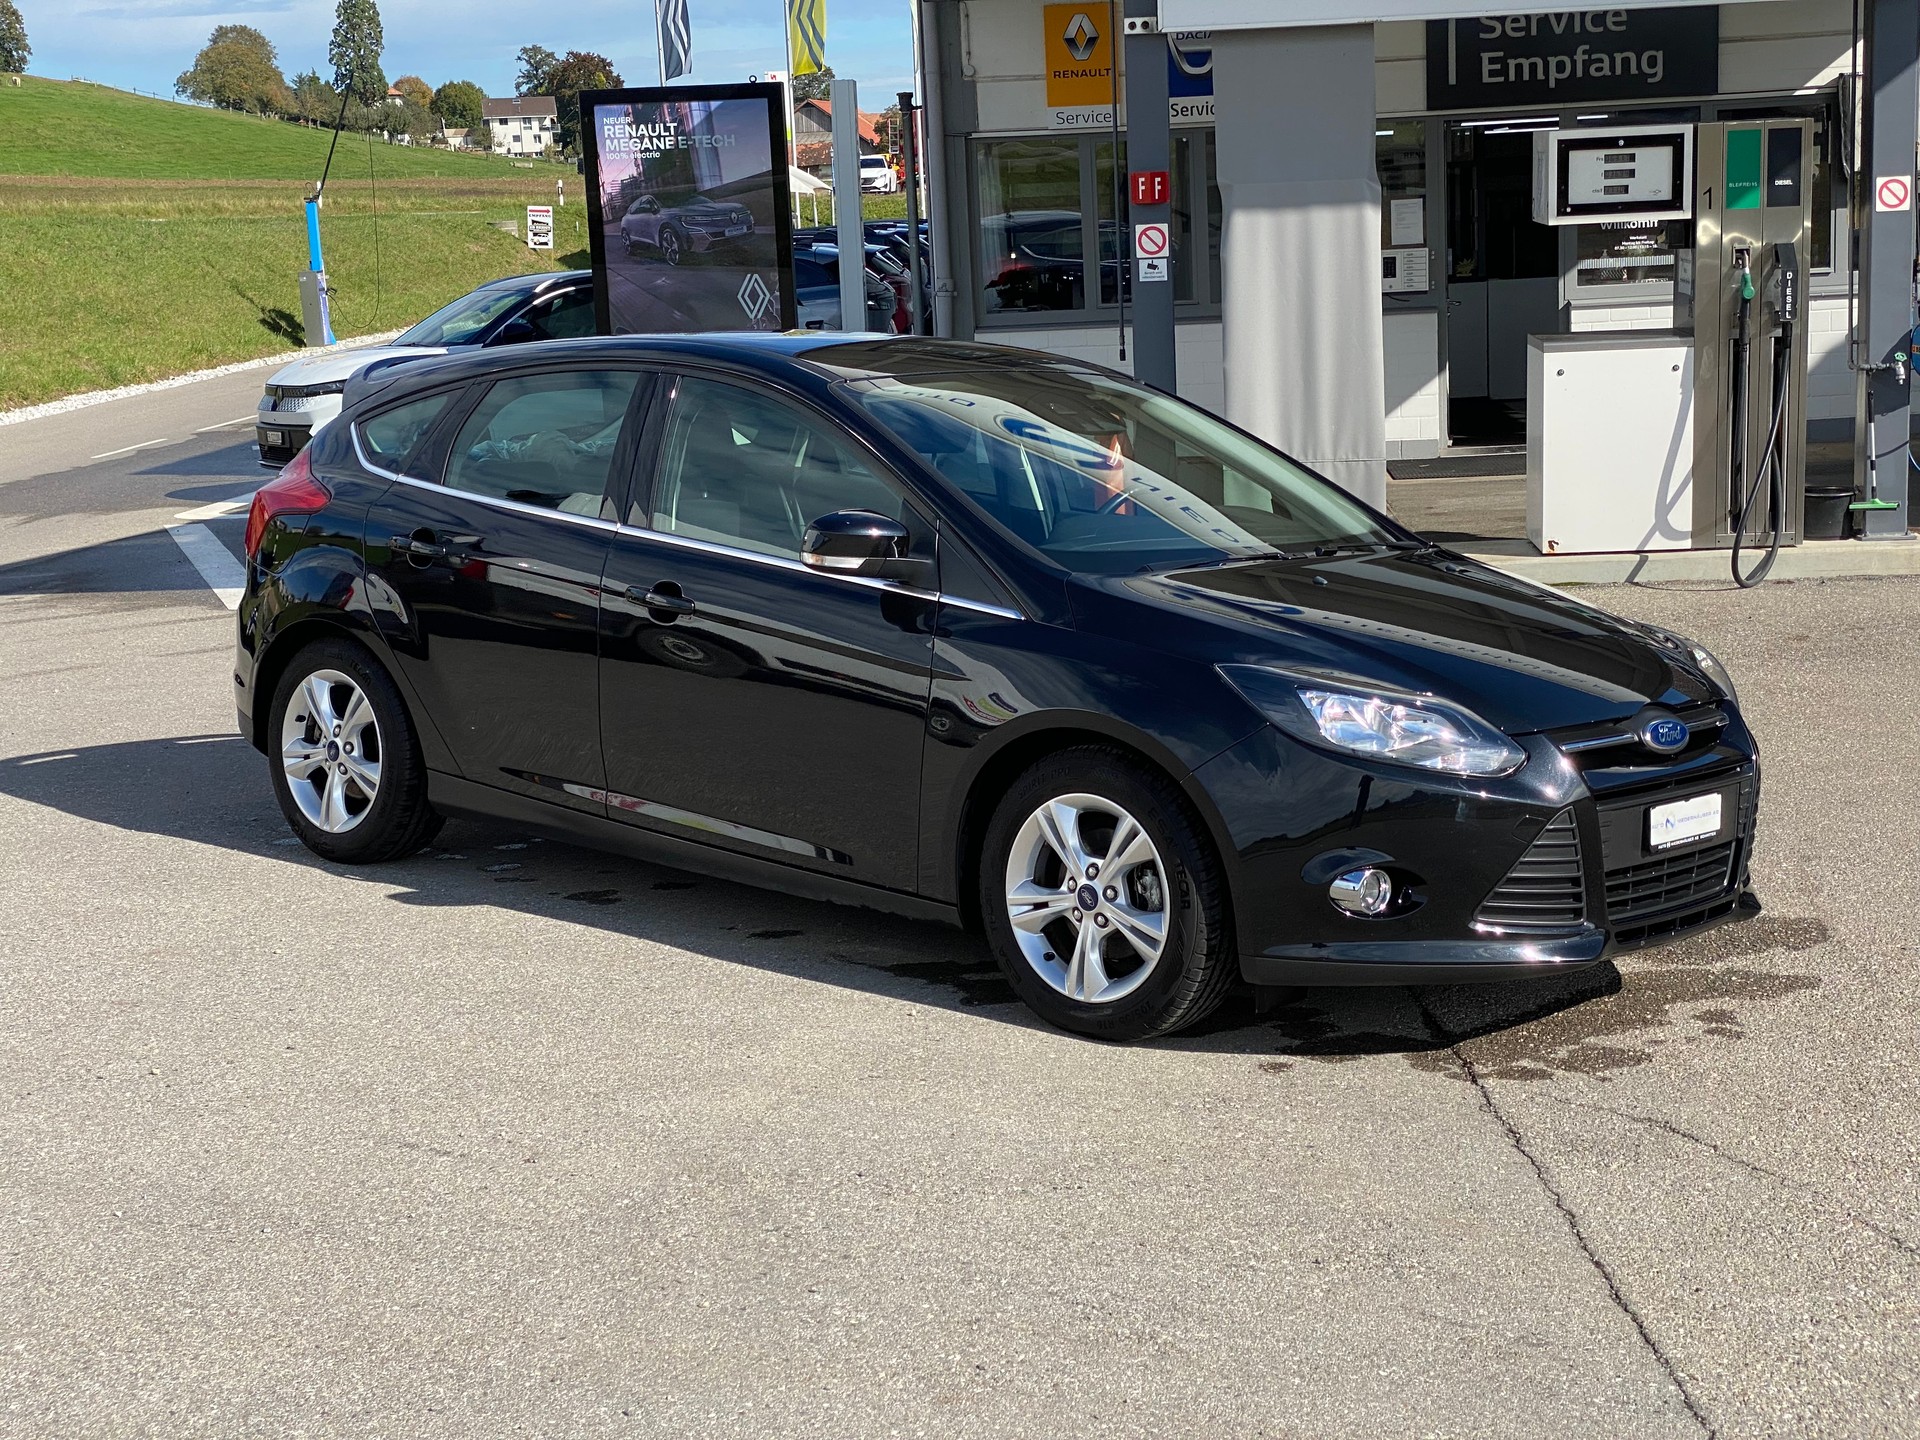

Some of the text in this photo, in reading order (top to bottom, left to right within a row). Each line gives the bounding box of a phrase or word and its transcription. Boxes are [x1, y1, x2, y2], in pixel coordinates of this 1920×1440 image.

[1053, 67, 1112, 79] RENAULT
[1480, 45, 1664, 88] Empfang
[1056, 110, 1112, 125] Service
[604, 122, 677, 138] RENAULT
[605, 134, 736, 152] MEGANE E-TECH
[606, 150, 661, 160] 100% electric
[1138, 177, 1162, 200] F F
[1702, 186, 1713, 210] 1
[1785, 271, 1793, 319] DIESEL
[1658, 723, 1682, 743] Ford
[1174, 857, 1191, 910] TECAR
